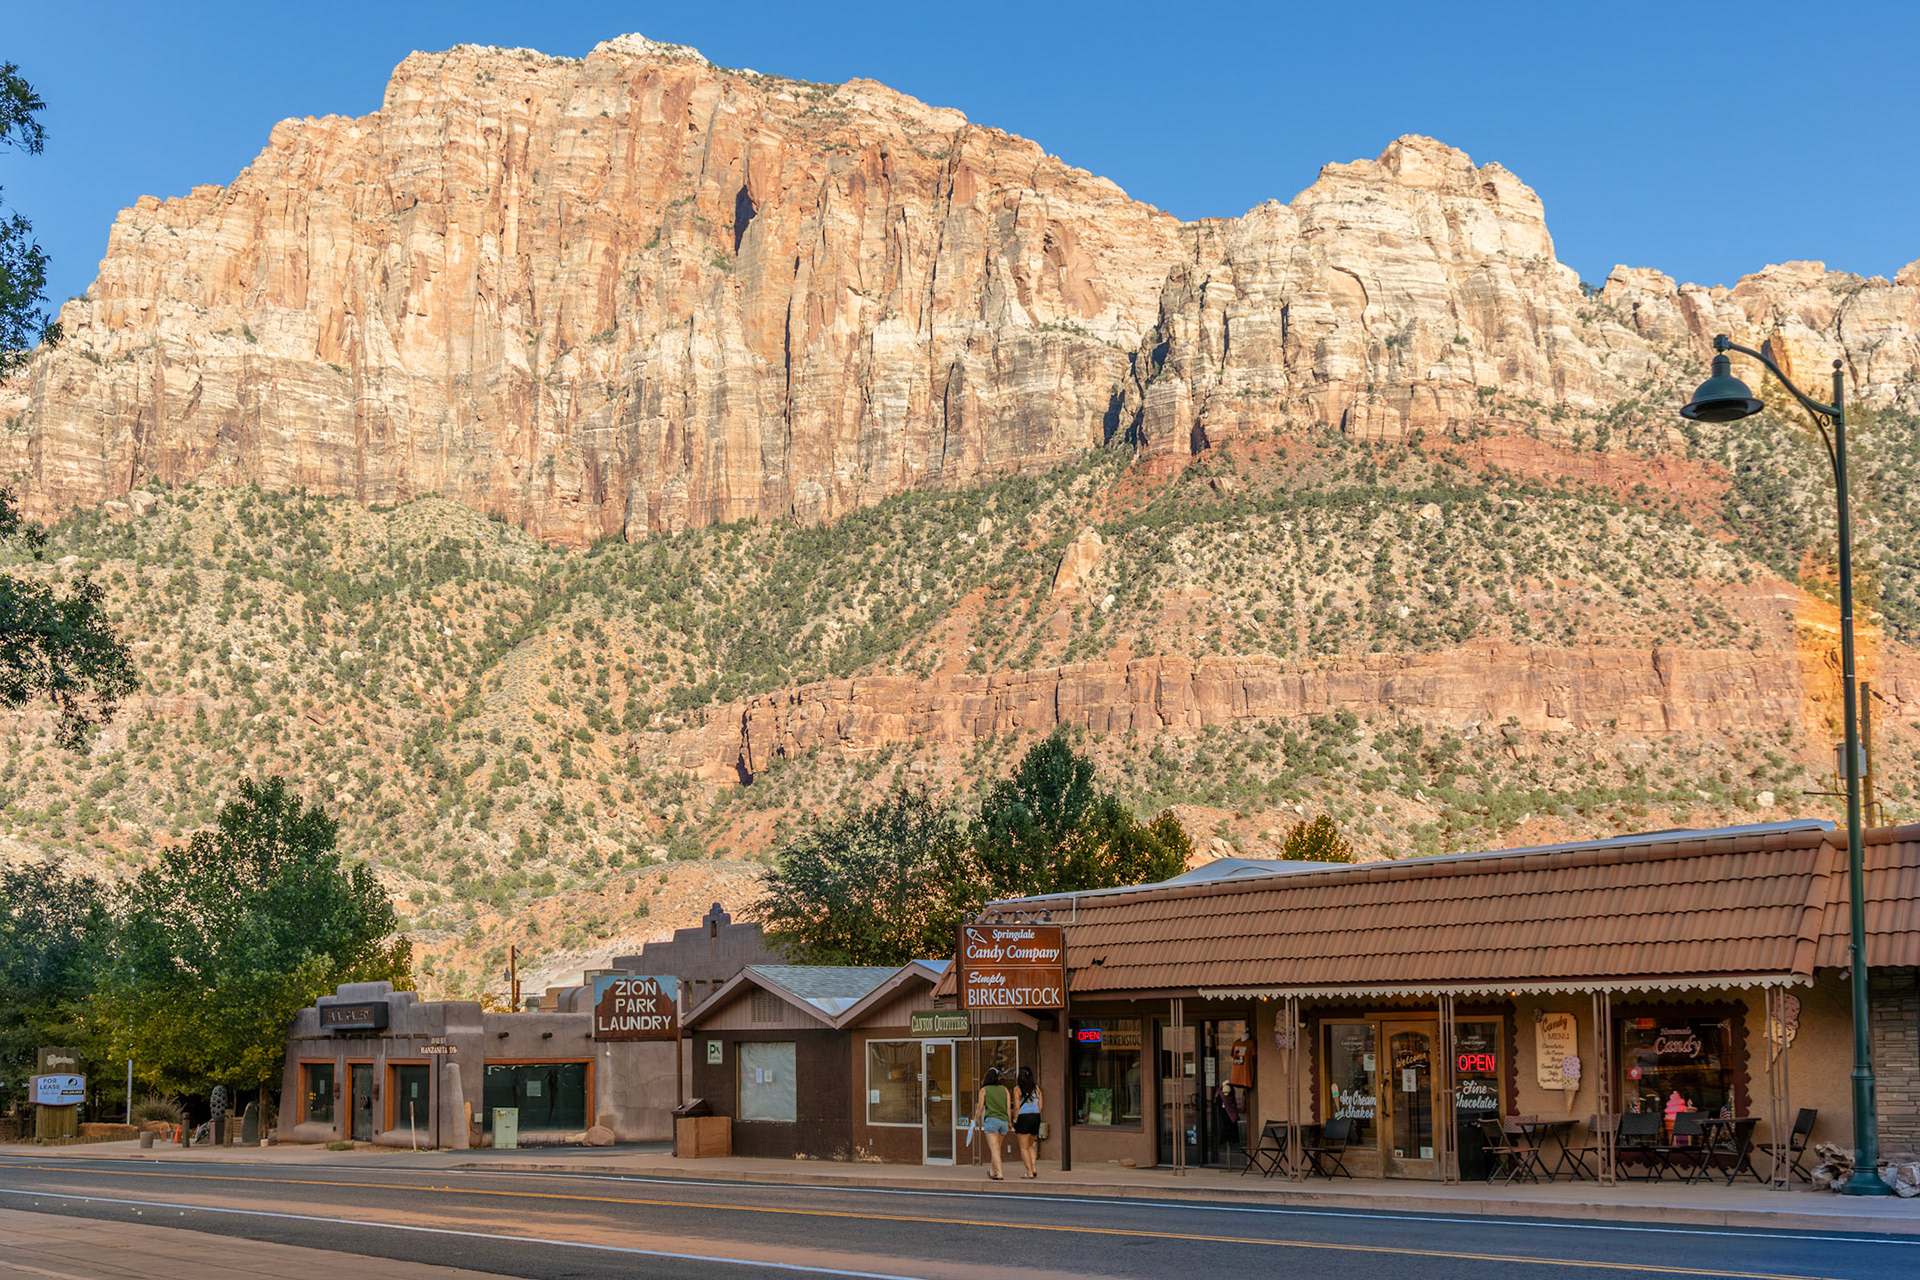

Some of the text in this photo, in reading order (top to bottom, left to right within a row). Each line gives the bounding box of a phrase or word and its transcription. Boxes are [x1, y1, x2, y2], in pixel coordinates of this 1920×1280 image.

[992, 929, 1035, 942] Springdale
[966, 944, 1060, 963] Candy Company
[968, 971, 1006, 986] Simply
[615, 980, 657, 996] ZION
[968, 987, 1061, 1006] BIRKENSTOCK
[615, 998, 657, 1013] PARK
[598, 1015, 672, 1031] LAUNDRY
[1542, 1015, 1568, 1033] Candy
[1078, 1030, 1100, 1041] OPEN
[1102, 1034, 1140, 1047] BIRKENSTOC
[1547, 1032, 1570, 1040] MENU
[1653, 1034, 1702, 1058] Candy
[1395, 1052, 1427, 1068] Welcome
[1458, 1054, 1496, 1071] OPEN
[1462, 1080, 1488, 1095] Fine
[1345, 1103, 1375, 1118] Shakes
